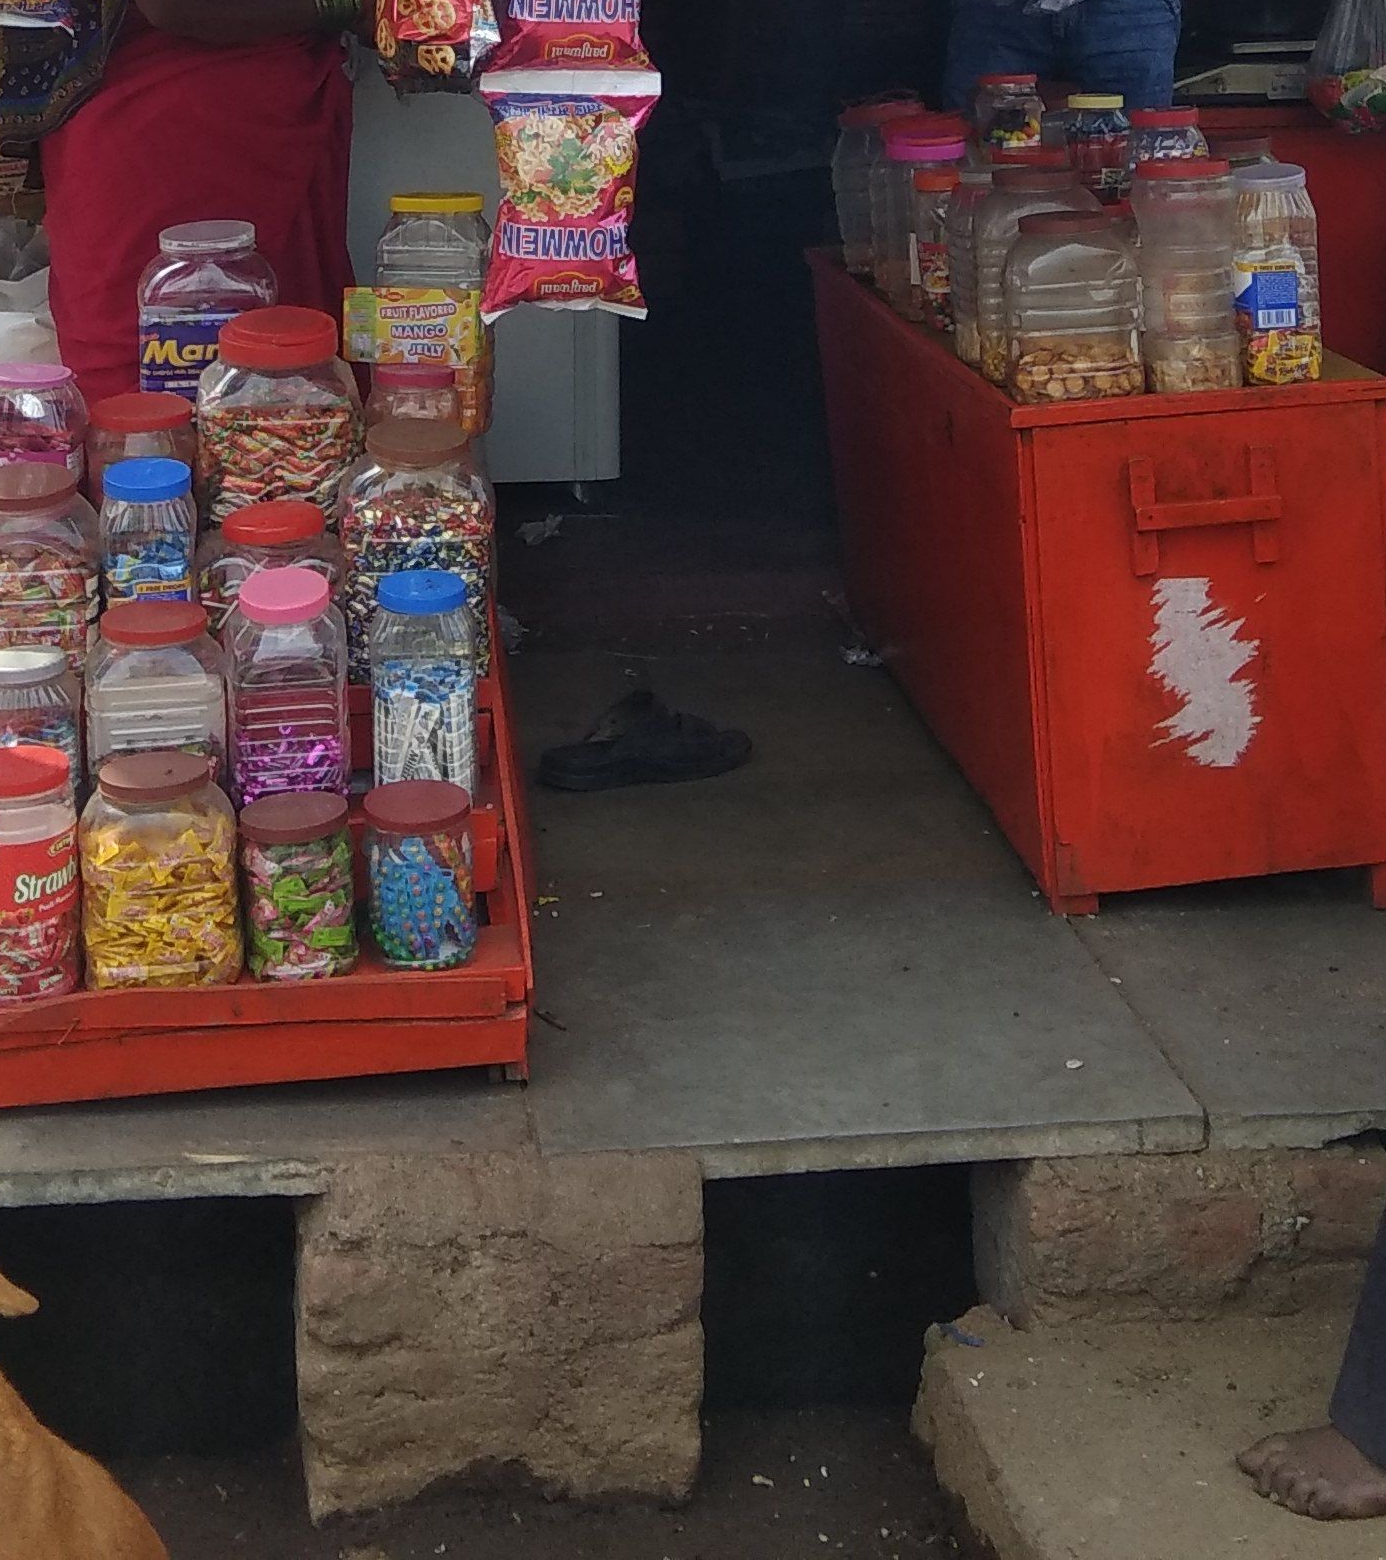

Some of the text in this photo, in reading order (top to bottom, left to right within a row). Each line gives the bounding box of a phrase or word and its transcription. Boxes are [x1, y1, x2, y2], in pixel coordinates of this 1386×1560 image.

[380, 303, 456, 319] FRUIT FLAVORED
[391, 324, 448, 339] MANGO
[408, 342, 445, 358] JELLY
